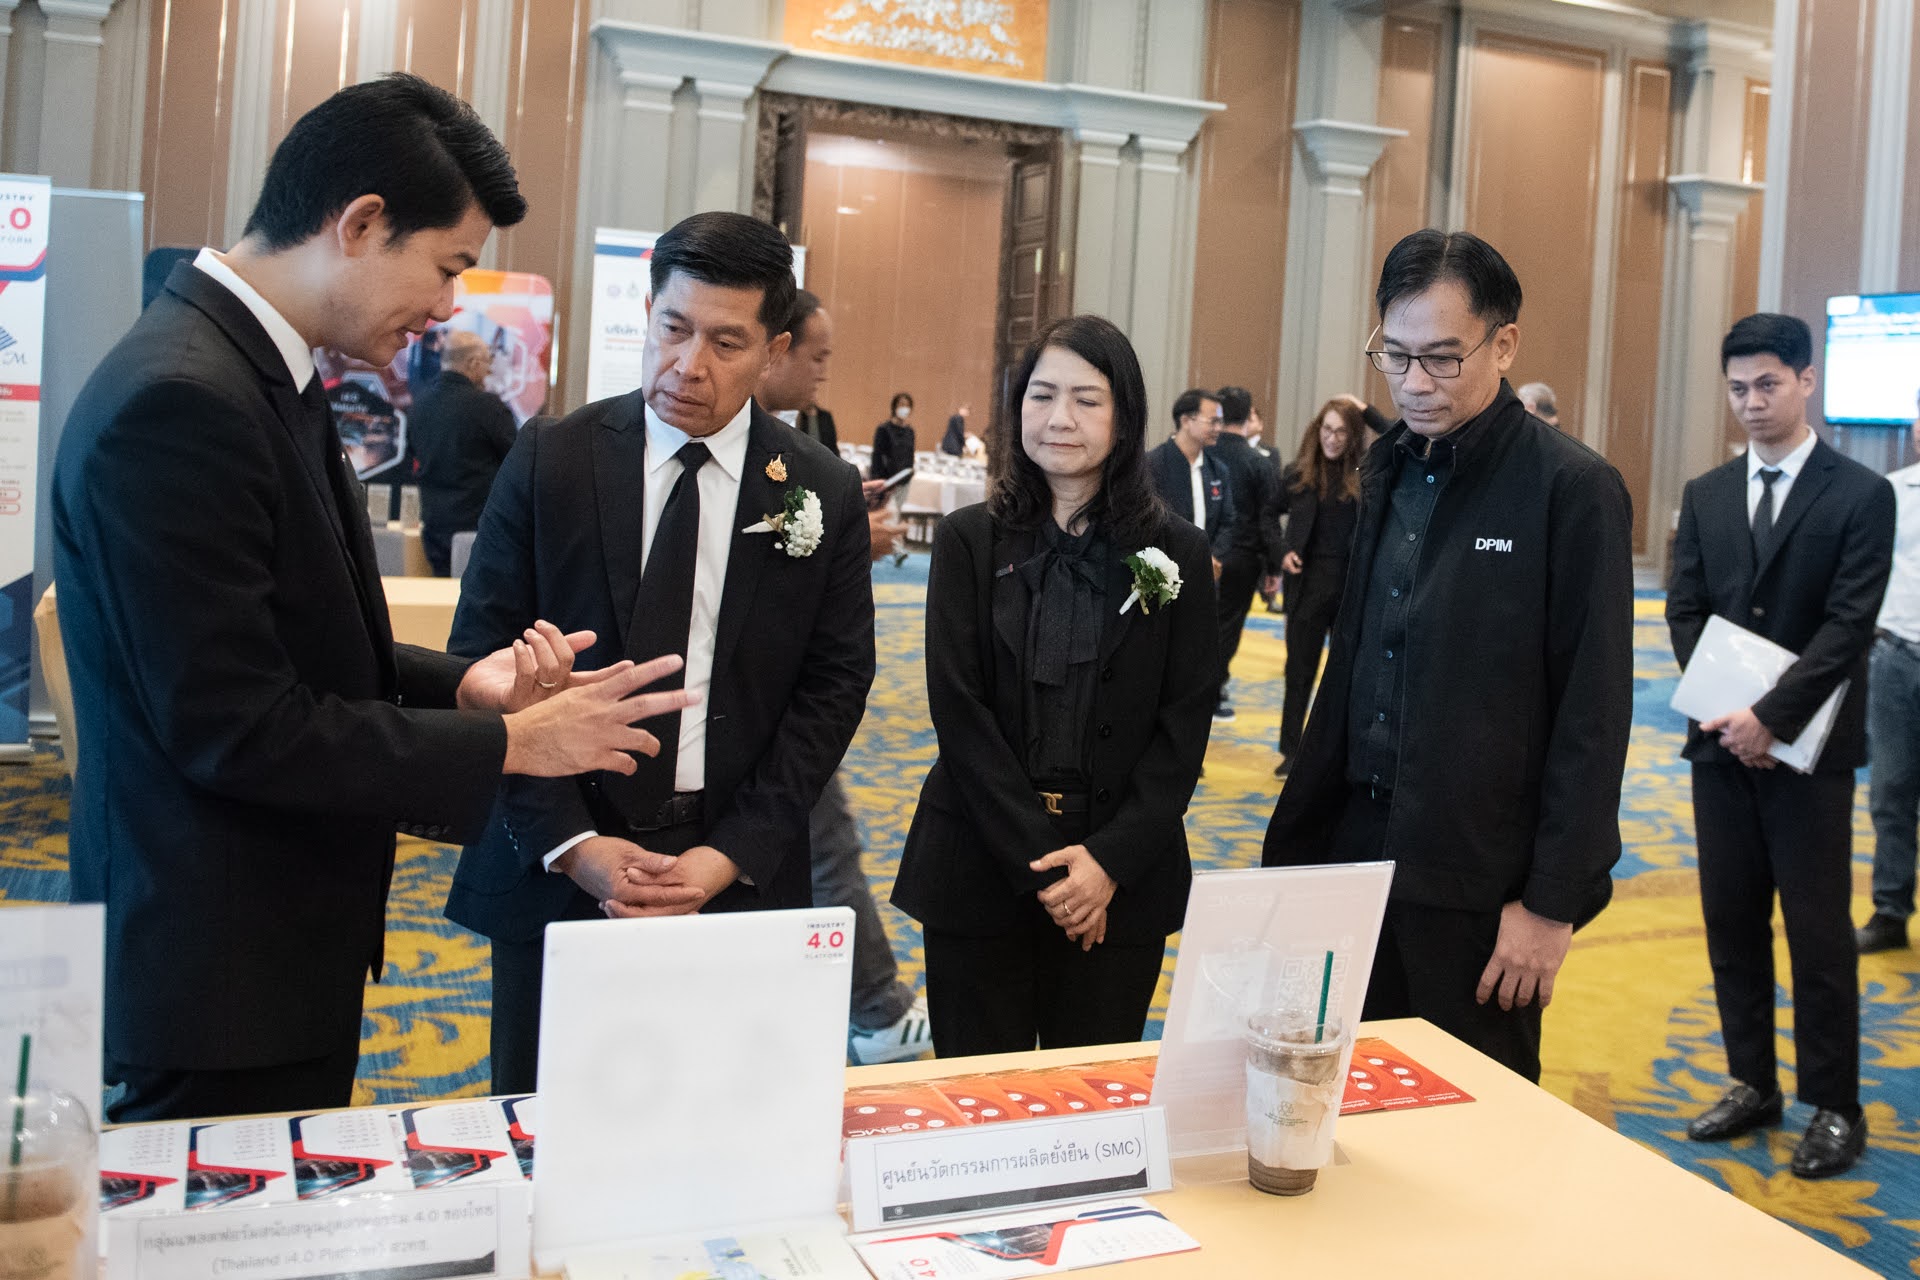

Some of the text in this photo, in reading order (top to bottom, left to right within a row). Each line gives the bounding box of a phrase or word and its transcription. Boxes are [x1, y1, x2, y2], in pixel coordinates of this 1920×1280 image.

[1475, 537, 1512, 552] DPIM
[807, 931, 844, 949] 4.0
[882, 1137, 1142, 1190] ศูนย์นวัตกรรมการผลิตยั่งยืน (SMC)
[415, 1211, 439, 1223] 4.0
[212, 1253, 281, 1275] (Thailand
